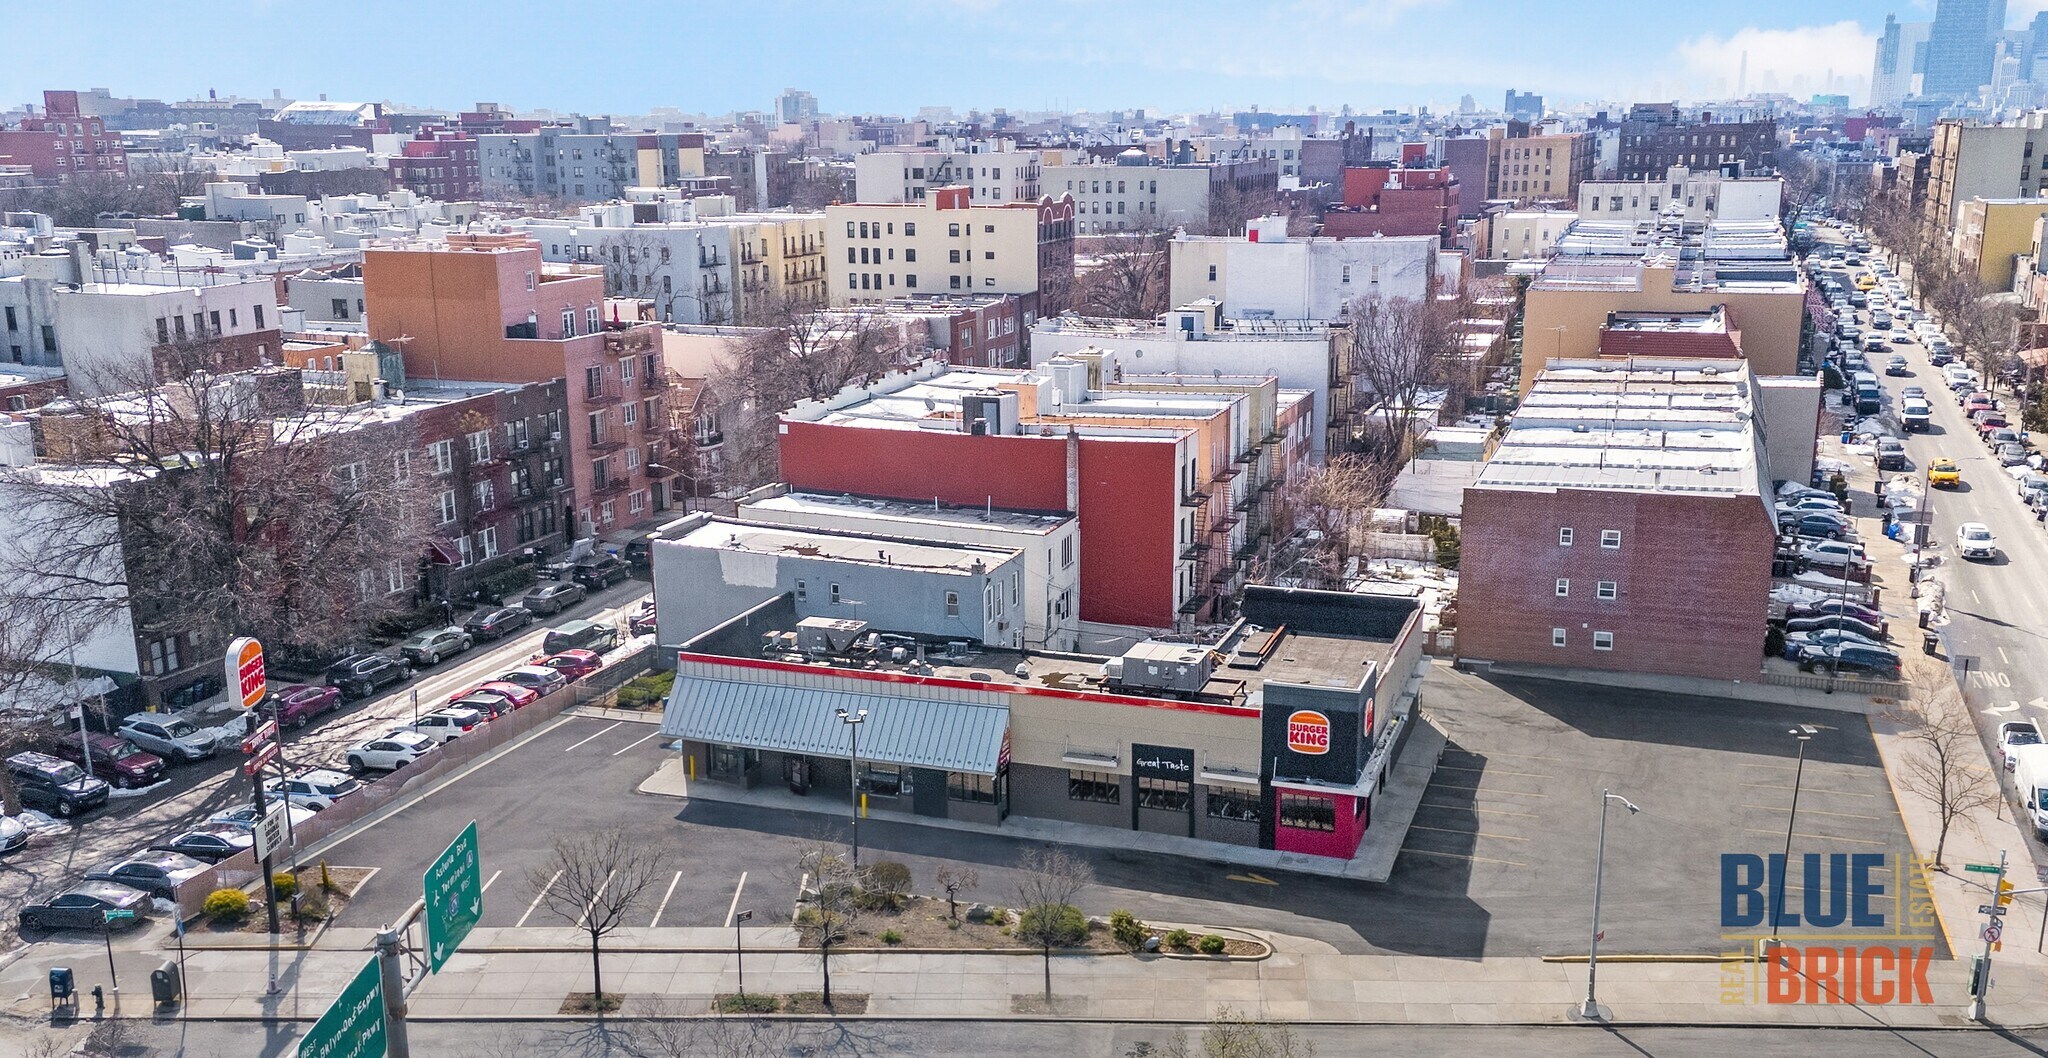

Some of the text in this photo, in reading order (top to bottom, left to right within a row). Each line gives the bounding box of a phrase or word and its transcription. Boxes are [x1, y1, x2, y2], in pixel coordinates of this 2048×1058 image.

[241, 667, 265, 699] KING
[1290, 723, 1328, 735] BURGER
[1290, 732, 1328, 746] KING
[1136, 757, 1189, 771] Great Taste
[436, 838, 467, 880] Astoria Blvd
[441, 862, 466, 895] Terminal
[362, 1018, 380, 1046] Pkwy
